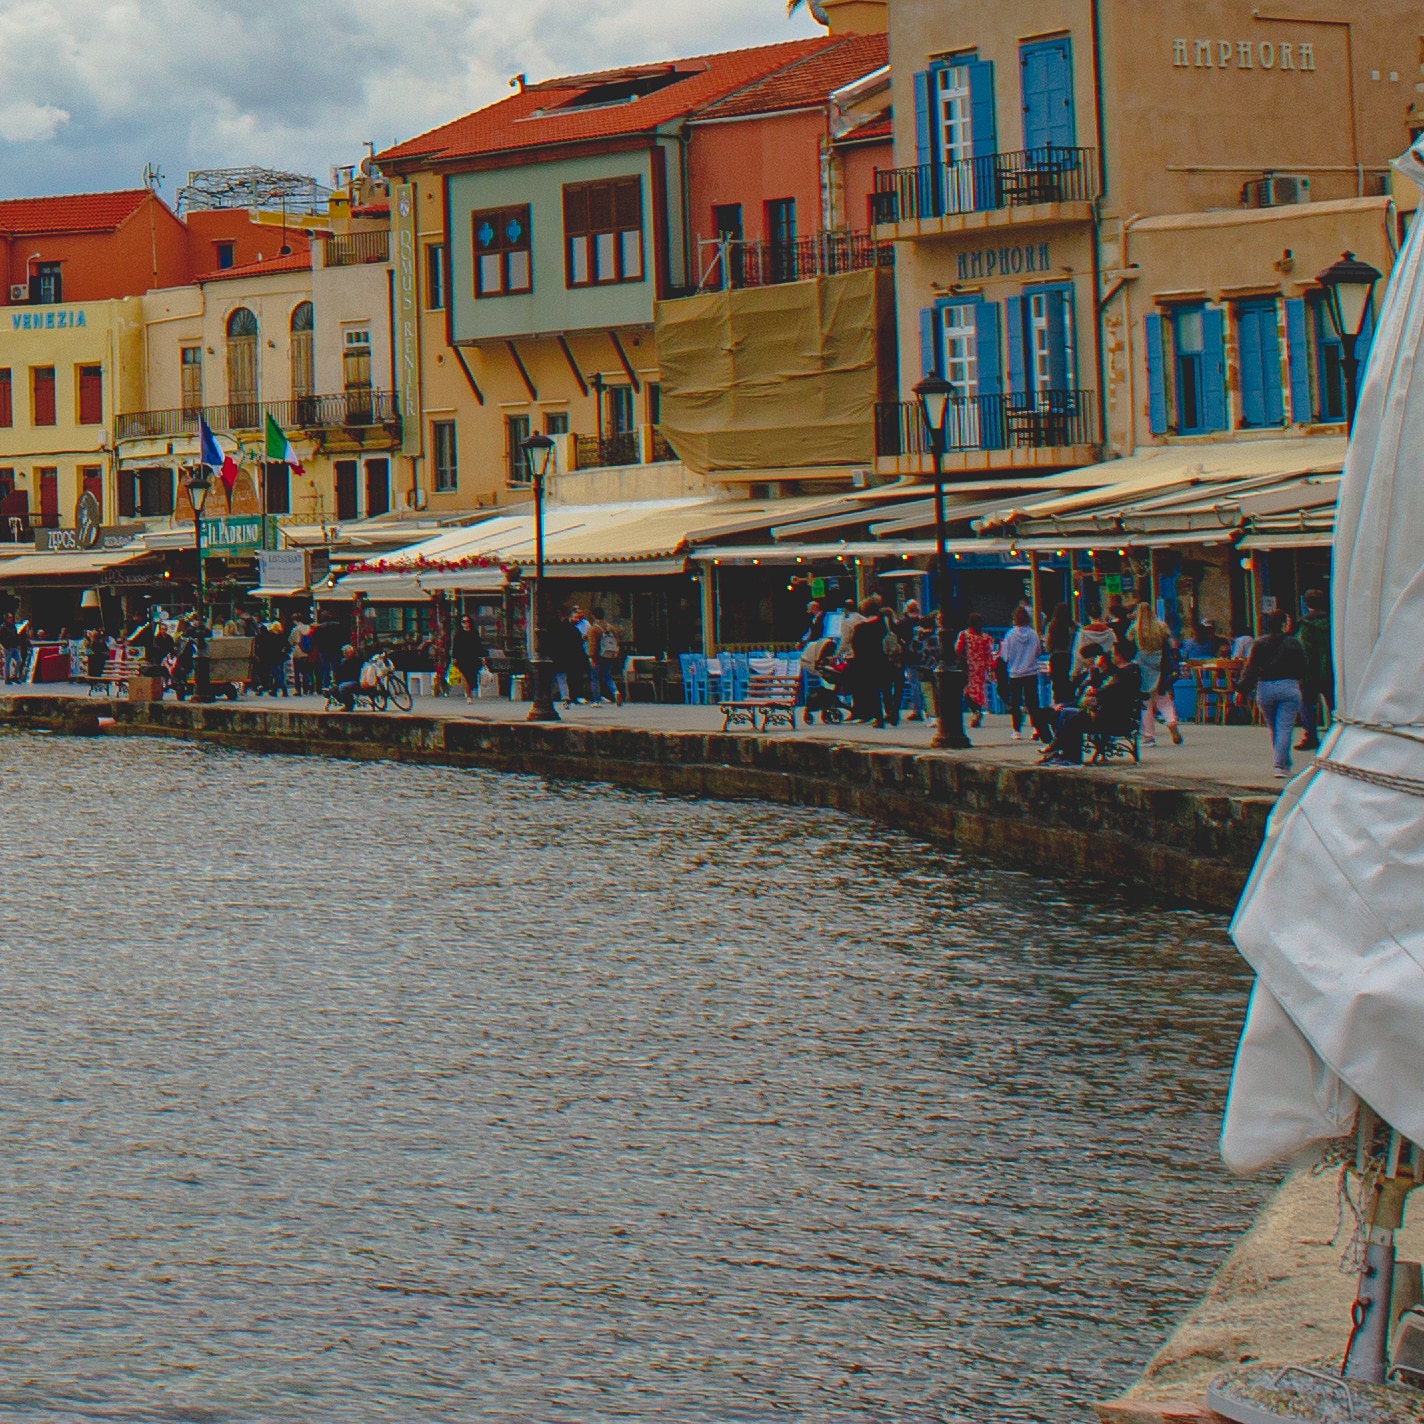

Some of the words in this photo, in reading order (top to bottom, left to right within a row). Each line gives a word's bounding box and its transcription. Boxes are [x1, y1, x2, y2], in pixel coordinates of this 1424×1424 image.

[1173, 39, 1316, 71] AMPHORA
[400, 229, 413, 310] DOMUS
[956, 241, 1050, 280] AMPHORA
[11, 310, 88, 331] VENEZIA
[404, 321, 416, 417] RENIER
